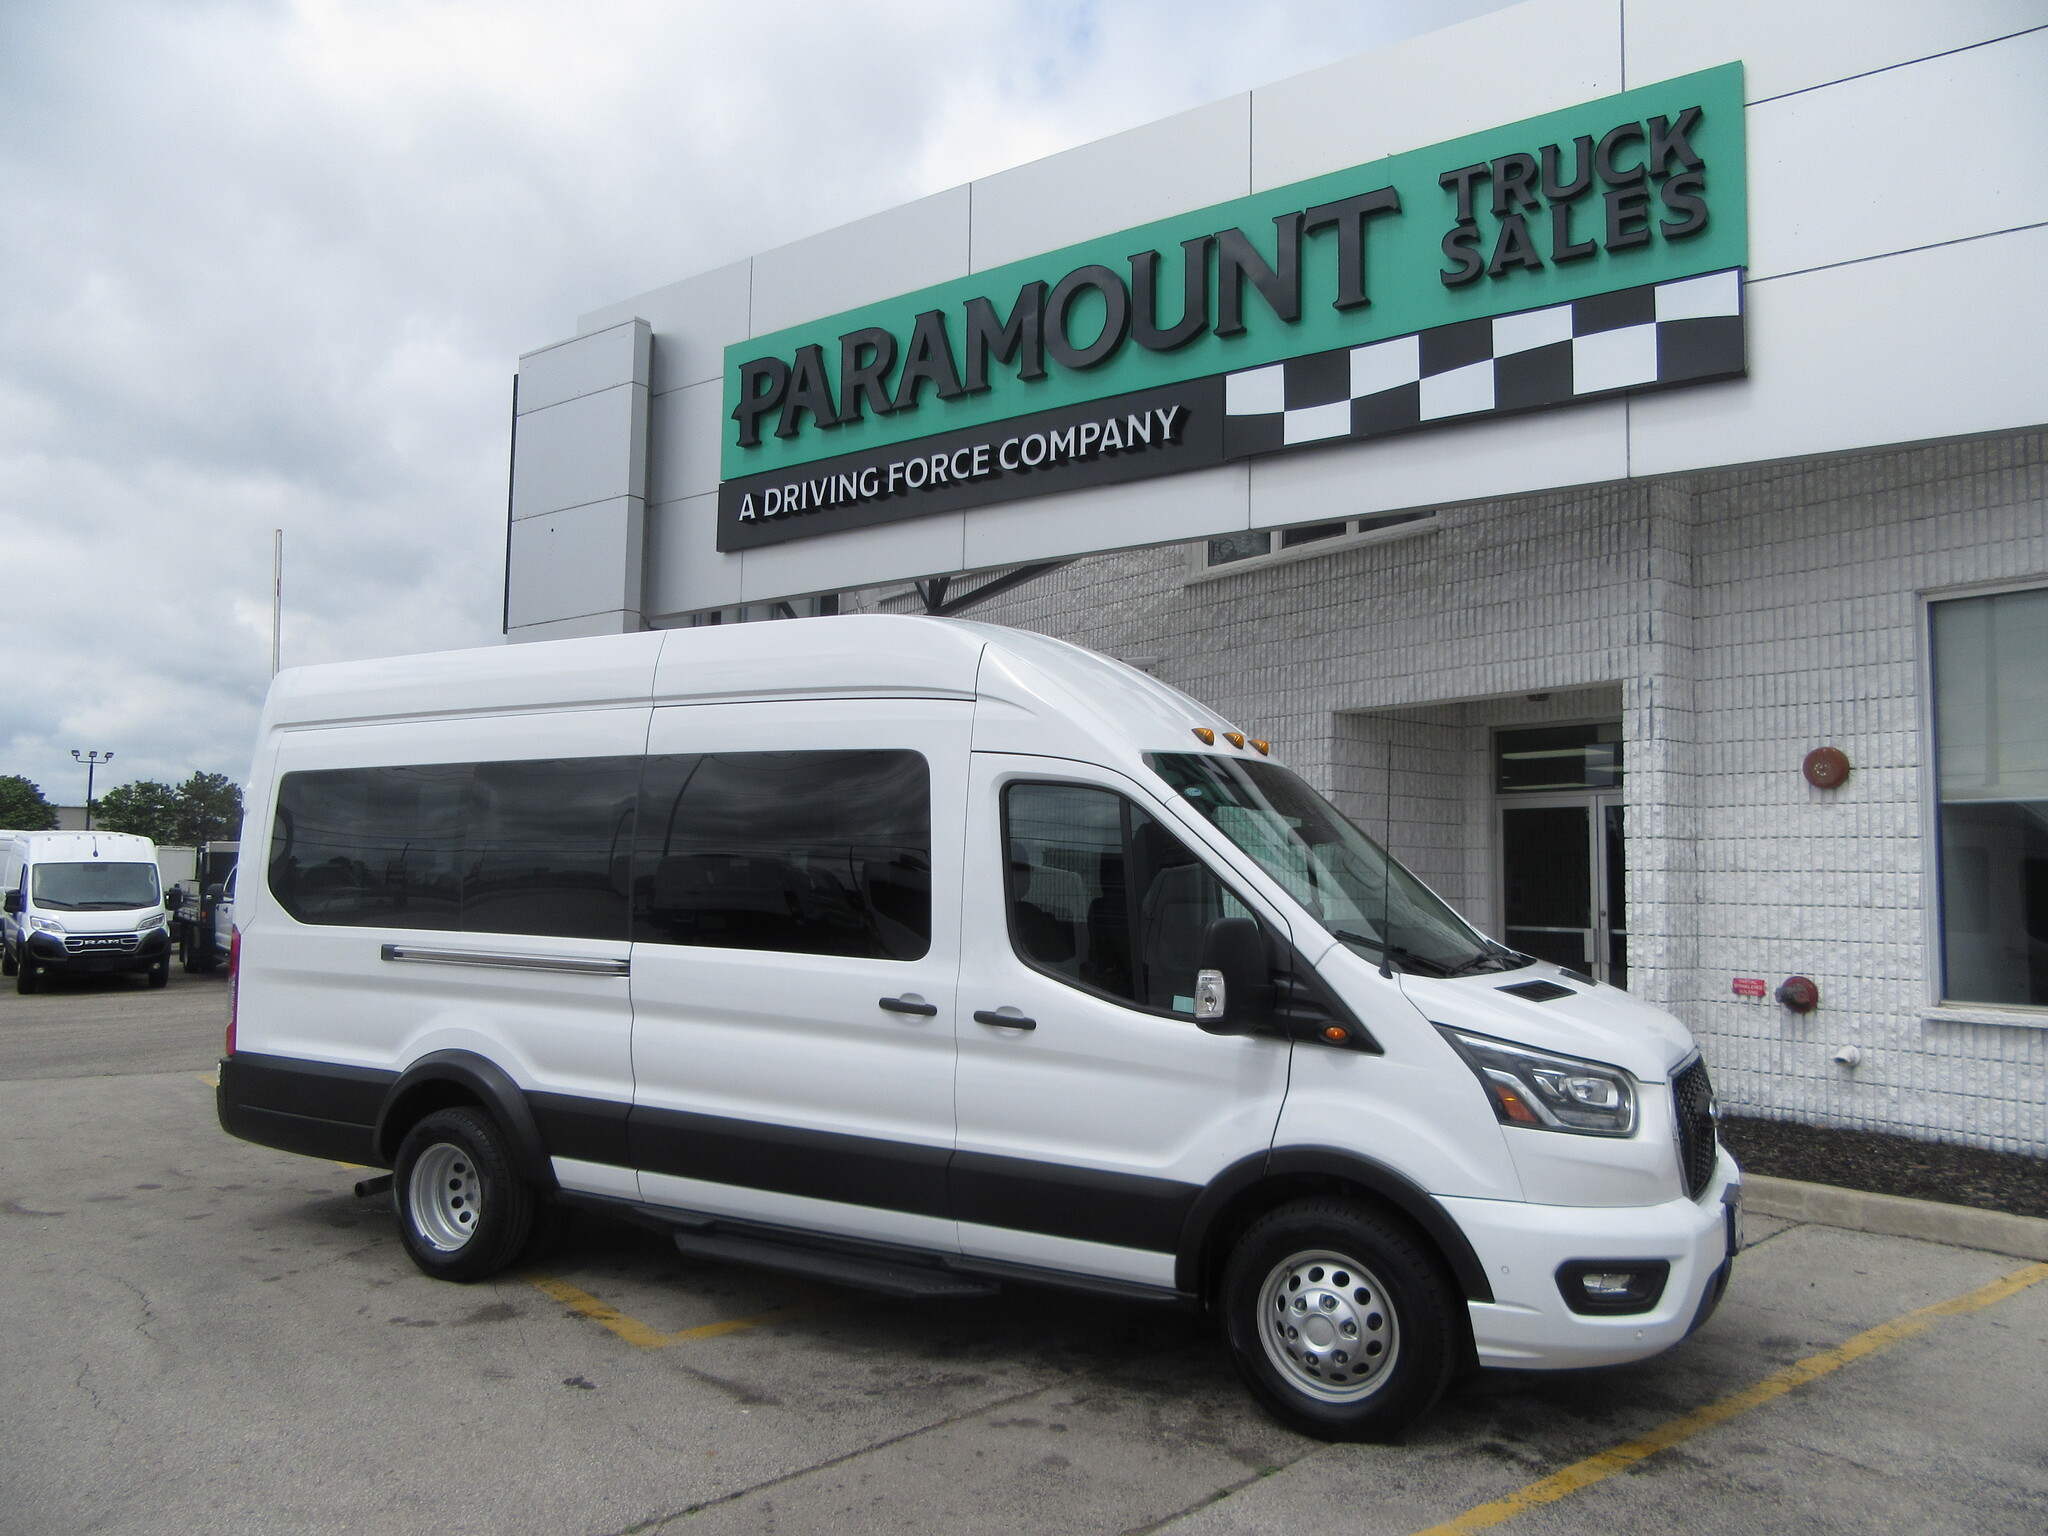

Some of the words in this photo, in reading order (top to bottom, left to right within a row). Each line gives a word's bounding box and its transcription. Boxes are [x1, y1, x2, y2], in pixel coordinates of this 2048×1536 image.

[1438, 105, 1706, 226] TRUCK
[1440, 171, 1709, 288] SALES
[732, 186, 1401, 447] PARAMOUNT
[738, 493, 757, 522] A
[763, 466, 880, 518] DRIVING
[887, 446, 991, 493] FORCE
[998, 405, 1181, 471] COMPANY
